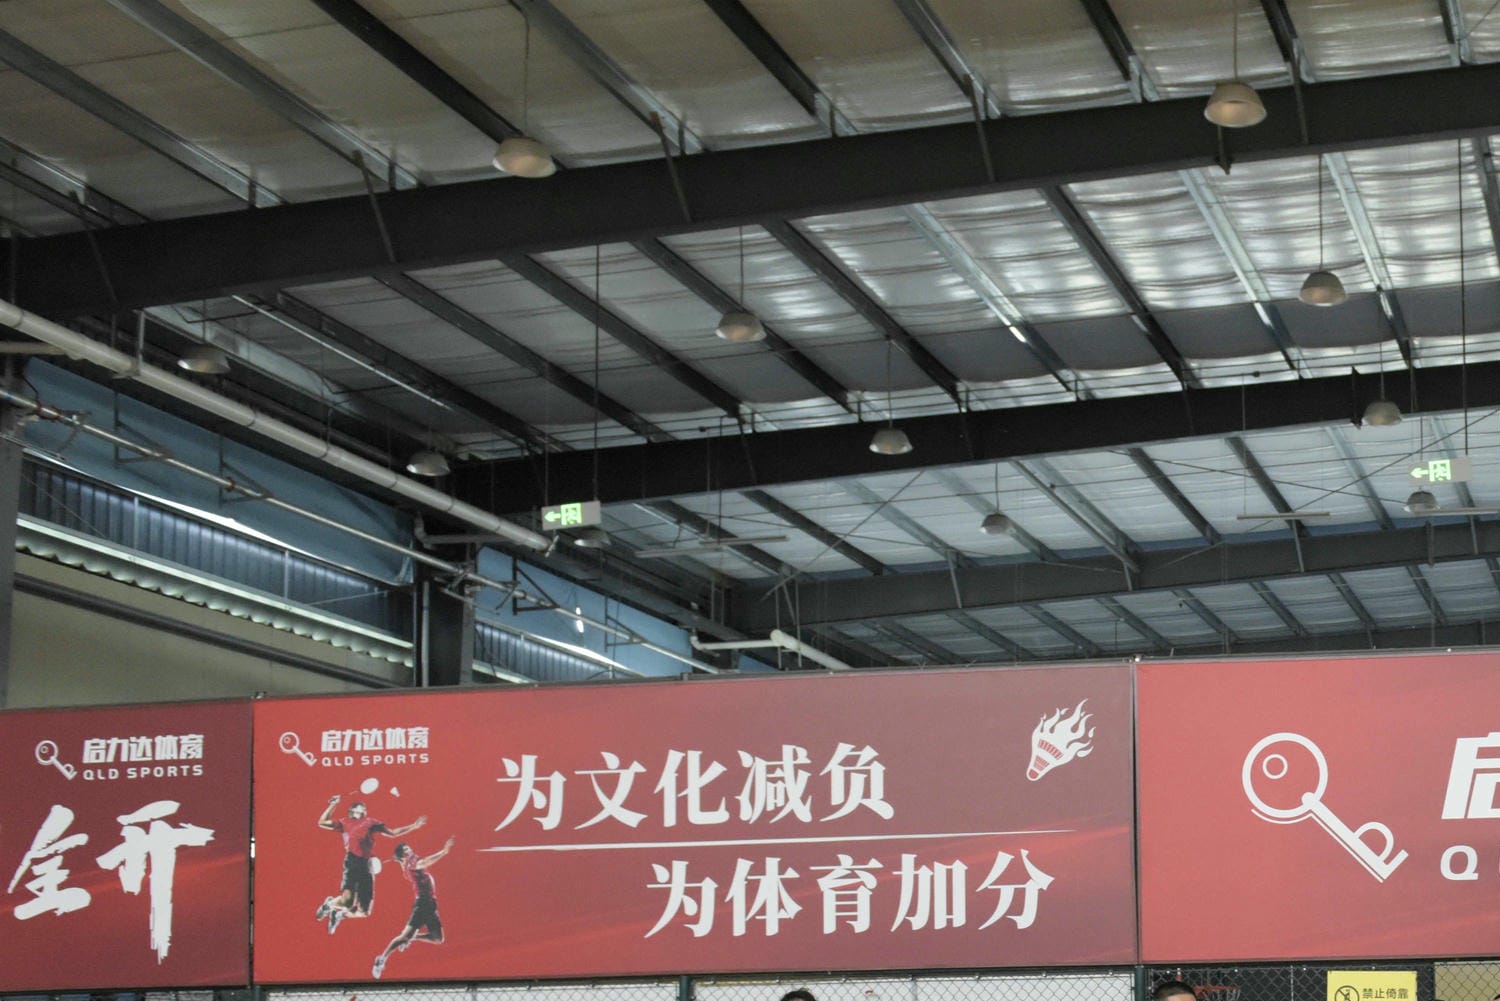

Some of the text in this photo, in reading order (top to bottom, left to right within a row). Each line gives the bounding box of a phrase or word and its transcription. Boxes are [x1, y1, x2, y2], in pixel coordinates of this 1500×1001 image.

[82, 733, 205, 764] 启力达体育
[321, 726, 430, 752] 启力达体育
[82, 763, 205, 781] QLD SPORTS
[321, 753, 430, 767] QLD SPORTS
[496, 743, 895, 832] 为文化减负
[8, 800, 215, 965] 全开
[645, 848, 1056, 938] 为体育加分
[1361, 987, 1409, 1000] 禁止倚靠
